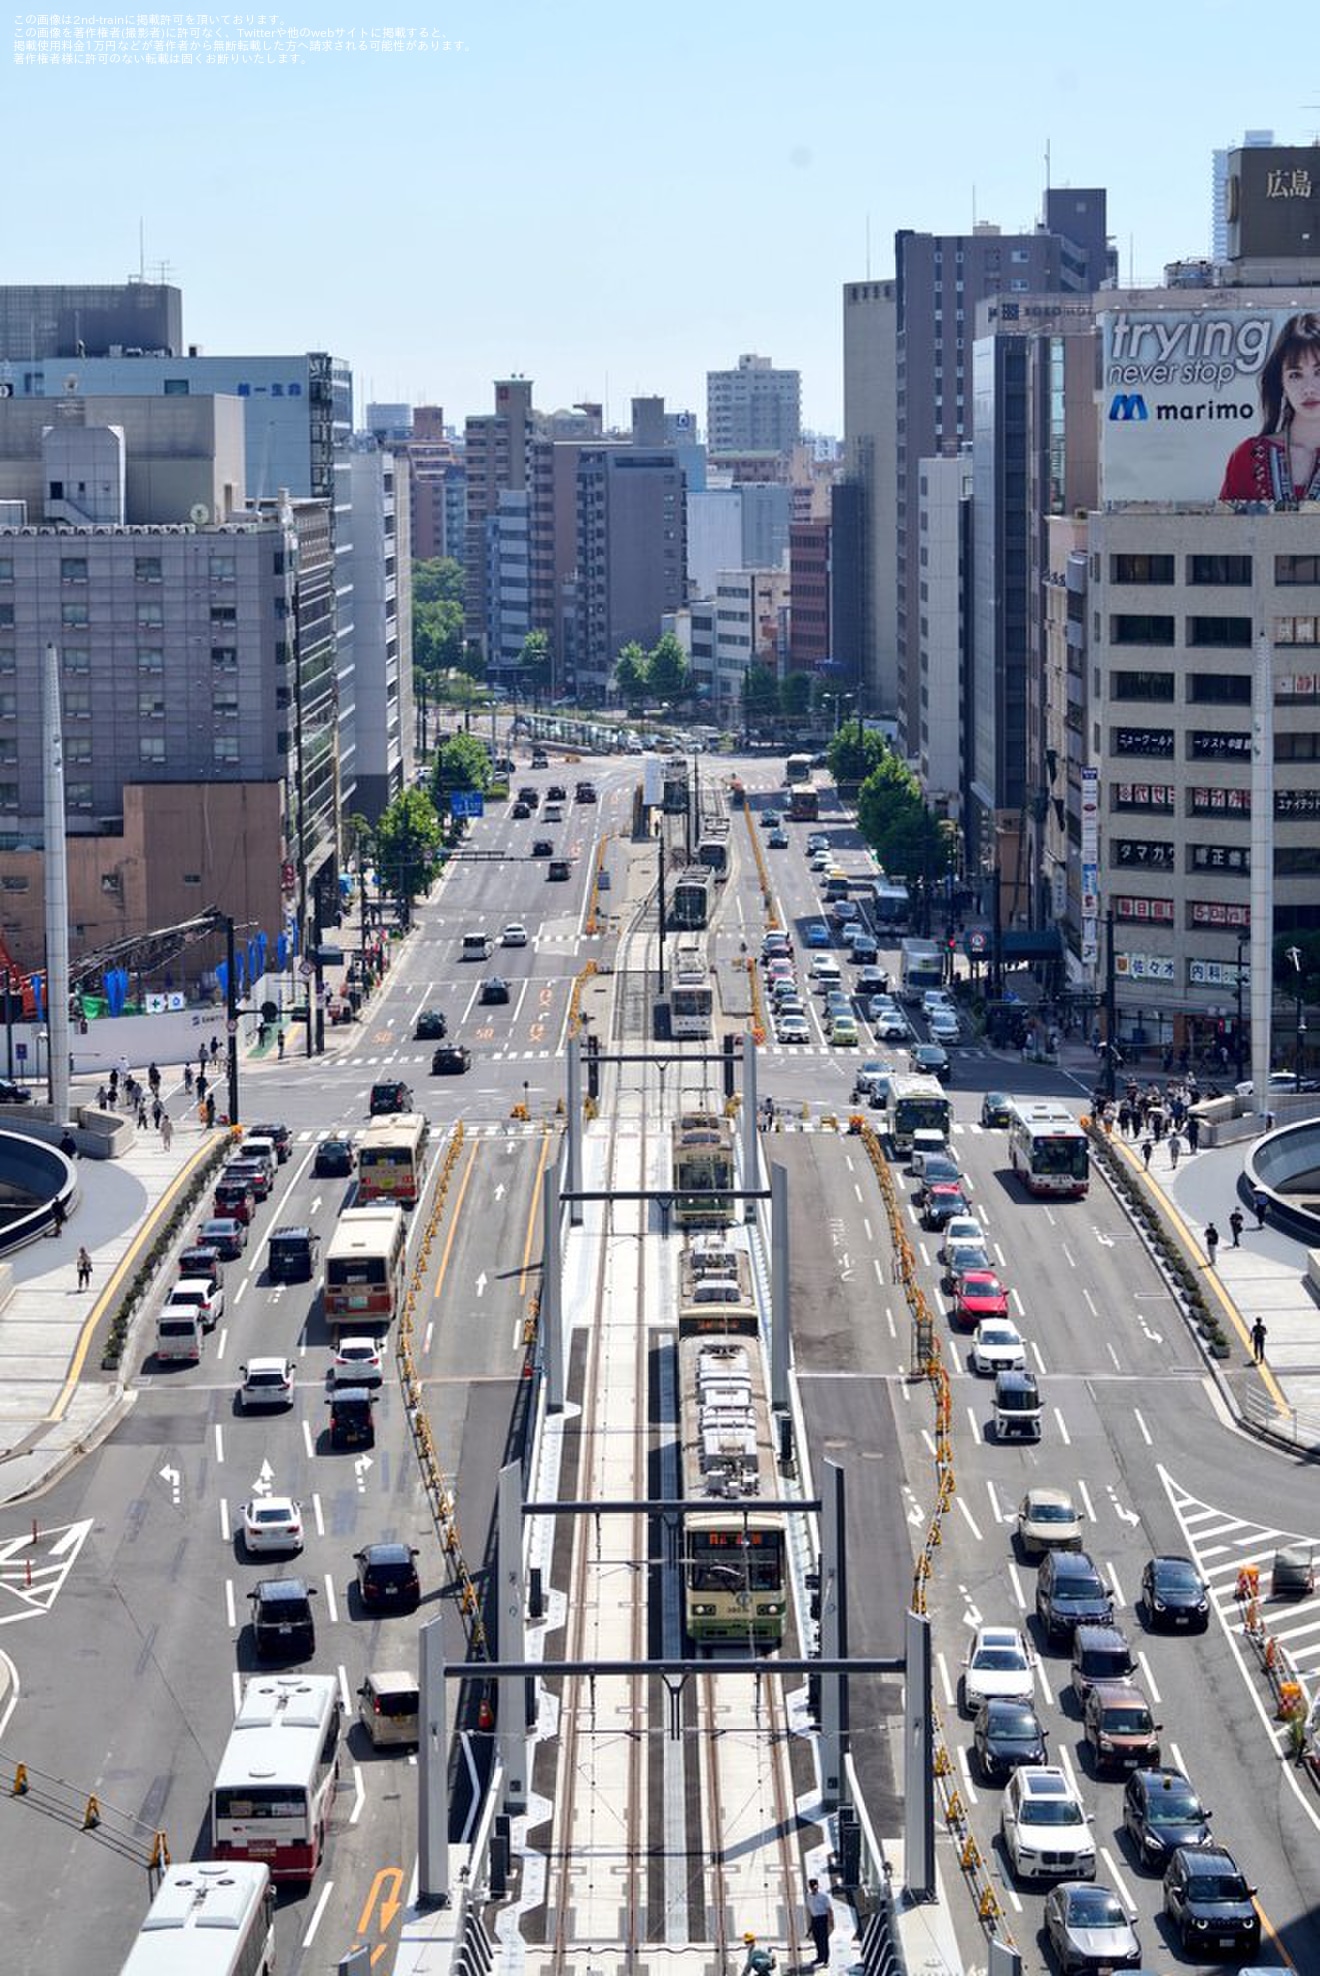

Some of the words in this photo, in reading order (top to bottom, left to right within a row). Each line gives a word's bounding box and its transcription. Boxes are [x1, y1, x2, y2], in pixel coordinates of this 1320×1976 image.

[1266, 169, 1313, 199] 広島
[1112, 311, 1272, 373] trying
[1108, 363, 1177, 386] never
[1180, 359, 1236, 391] stop
[1156, 401, 1255, 422] marimo
